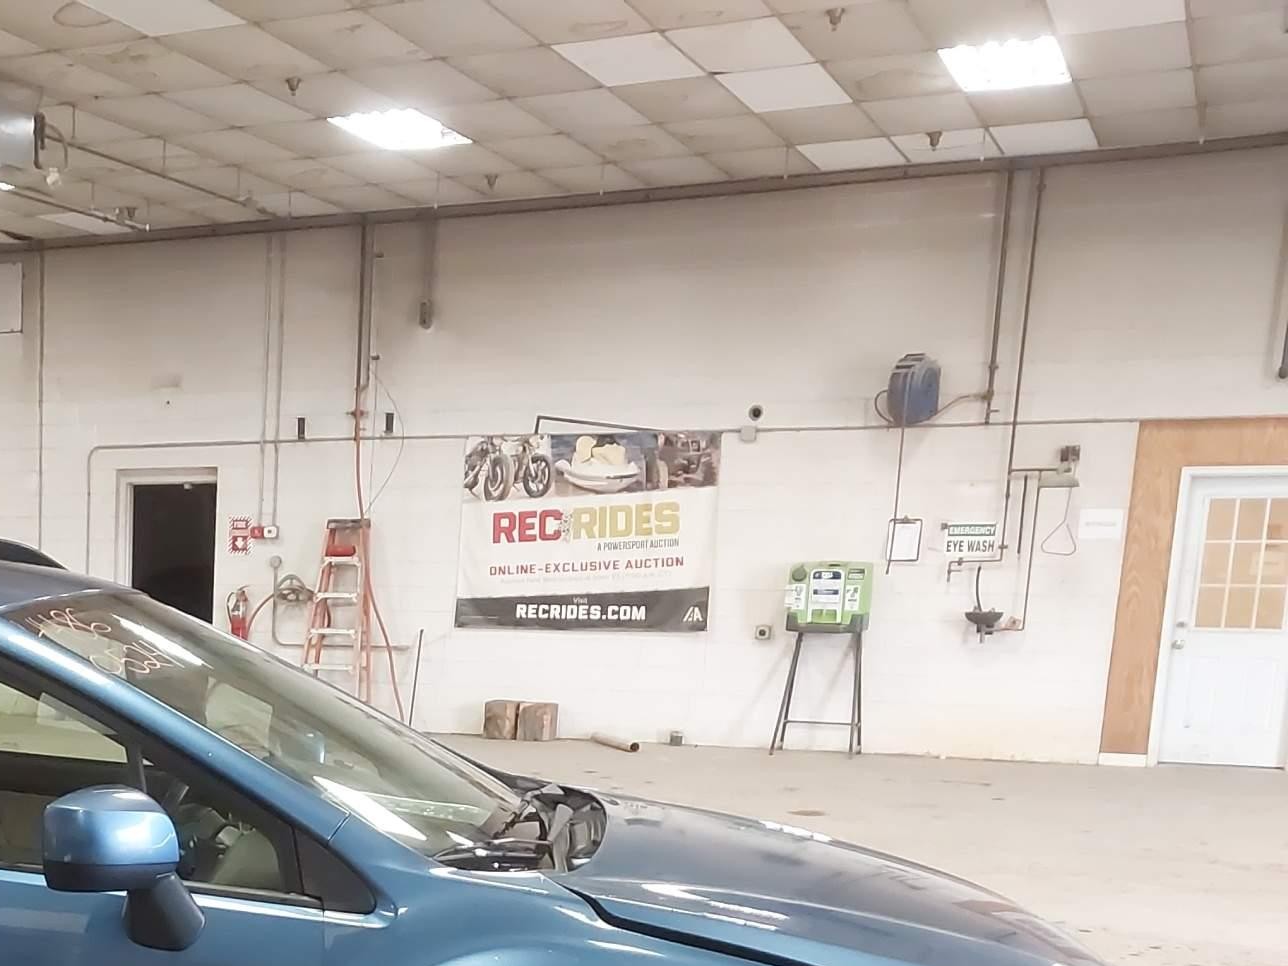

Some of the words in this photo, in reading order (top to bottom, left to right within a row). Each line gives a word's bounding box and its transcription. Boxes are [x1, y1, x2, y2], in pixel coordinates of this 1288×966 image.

[492, 508, 563, 544] REC
[572, 501, 681, 540] RIDES
[597, 542, 602, 551] A
[603, 539, 648, 552] POWERSPORT
[649, 536, 680, 548] AUCTION
[946, 540, 964, 552] EYE
[967, 540, 995, 553] WASH
[489, 559, 620, 576] ONLINE-EXCLUSIVE
[624, 556, 684, 570] AUCTION
[515, 603, 646, 621] RECRIDES.COM
